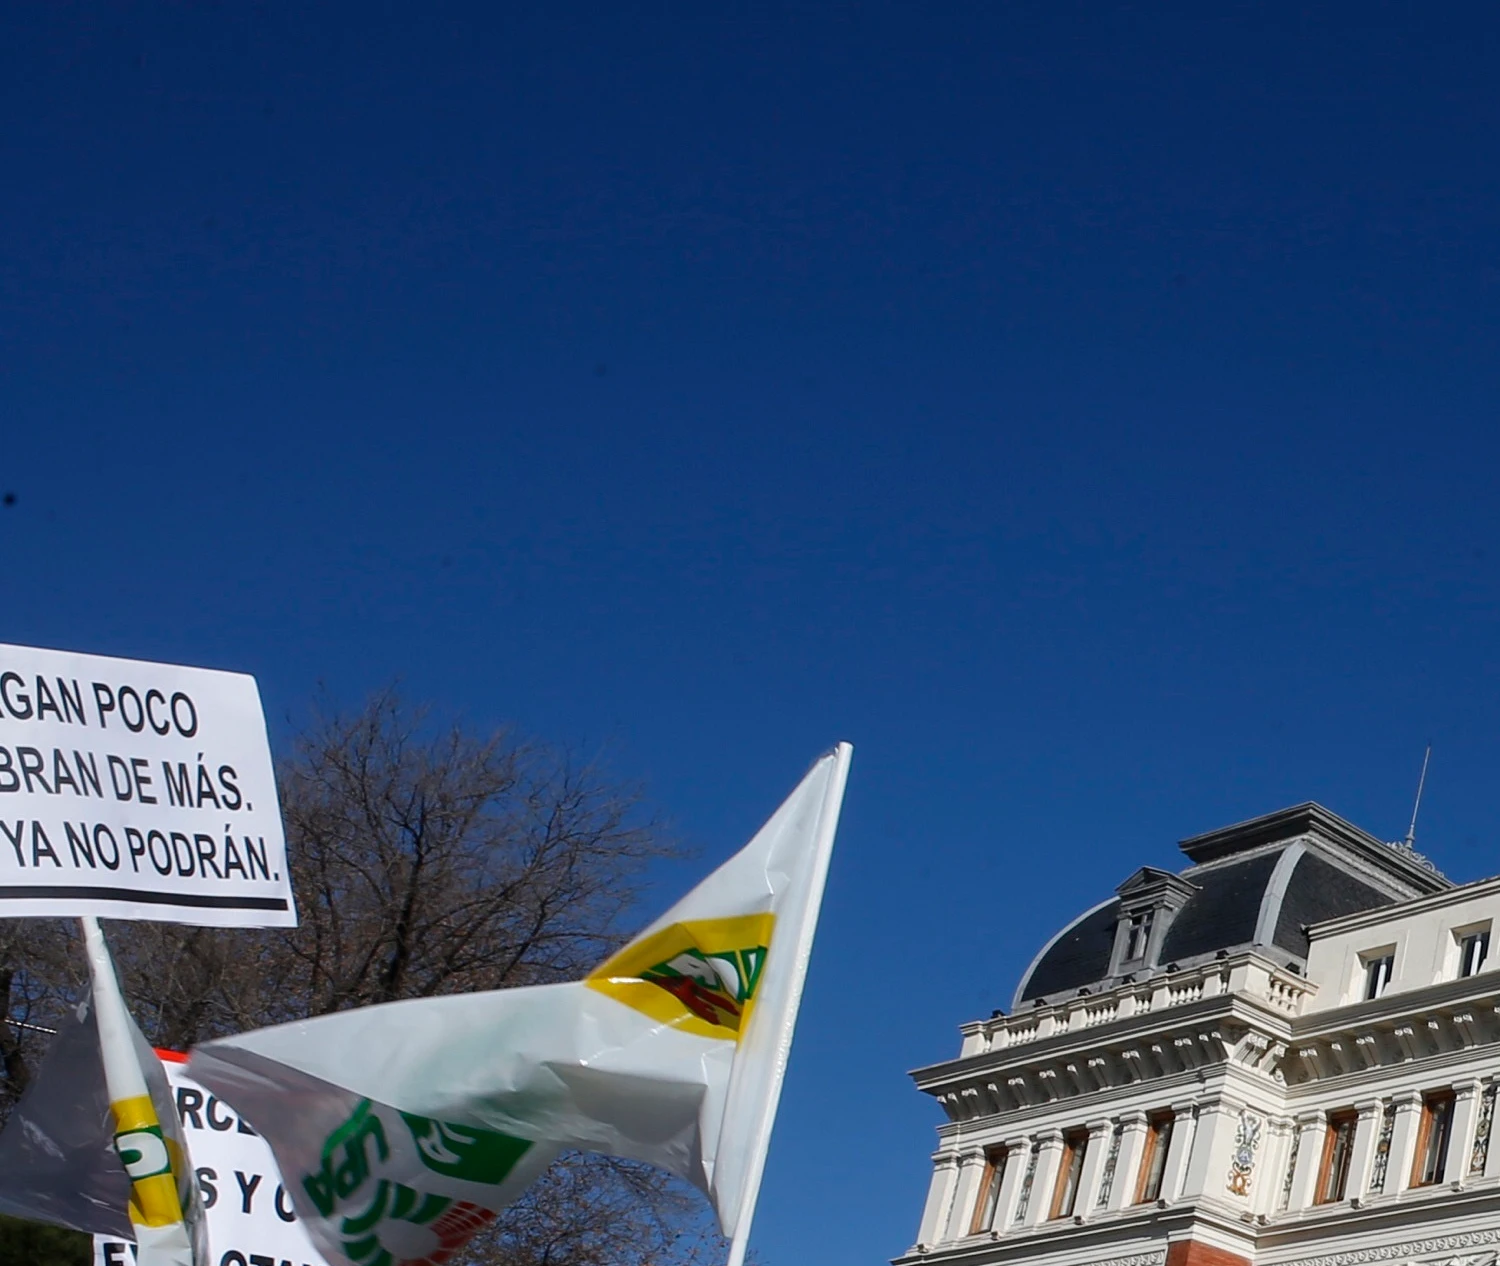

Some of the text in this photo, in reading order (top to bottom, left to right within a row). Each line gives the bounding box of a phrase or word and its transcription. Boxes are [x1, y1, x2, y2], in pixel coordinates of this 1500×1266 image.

[92, 682, 198, 738] POCO
[107, 754, 157, 804] DE
[162, 752, 253, 812] MÁS.
[0, 820, 280, 881] YA NO PODRÁN.
[234, 1171, 262, 1214] Y
